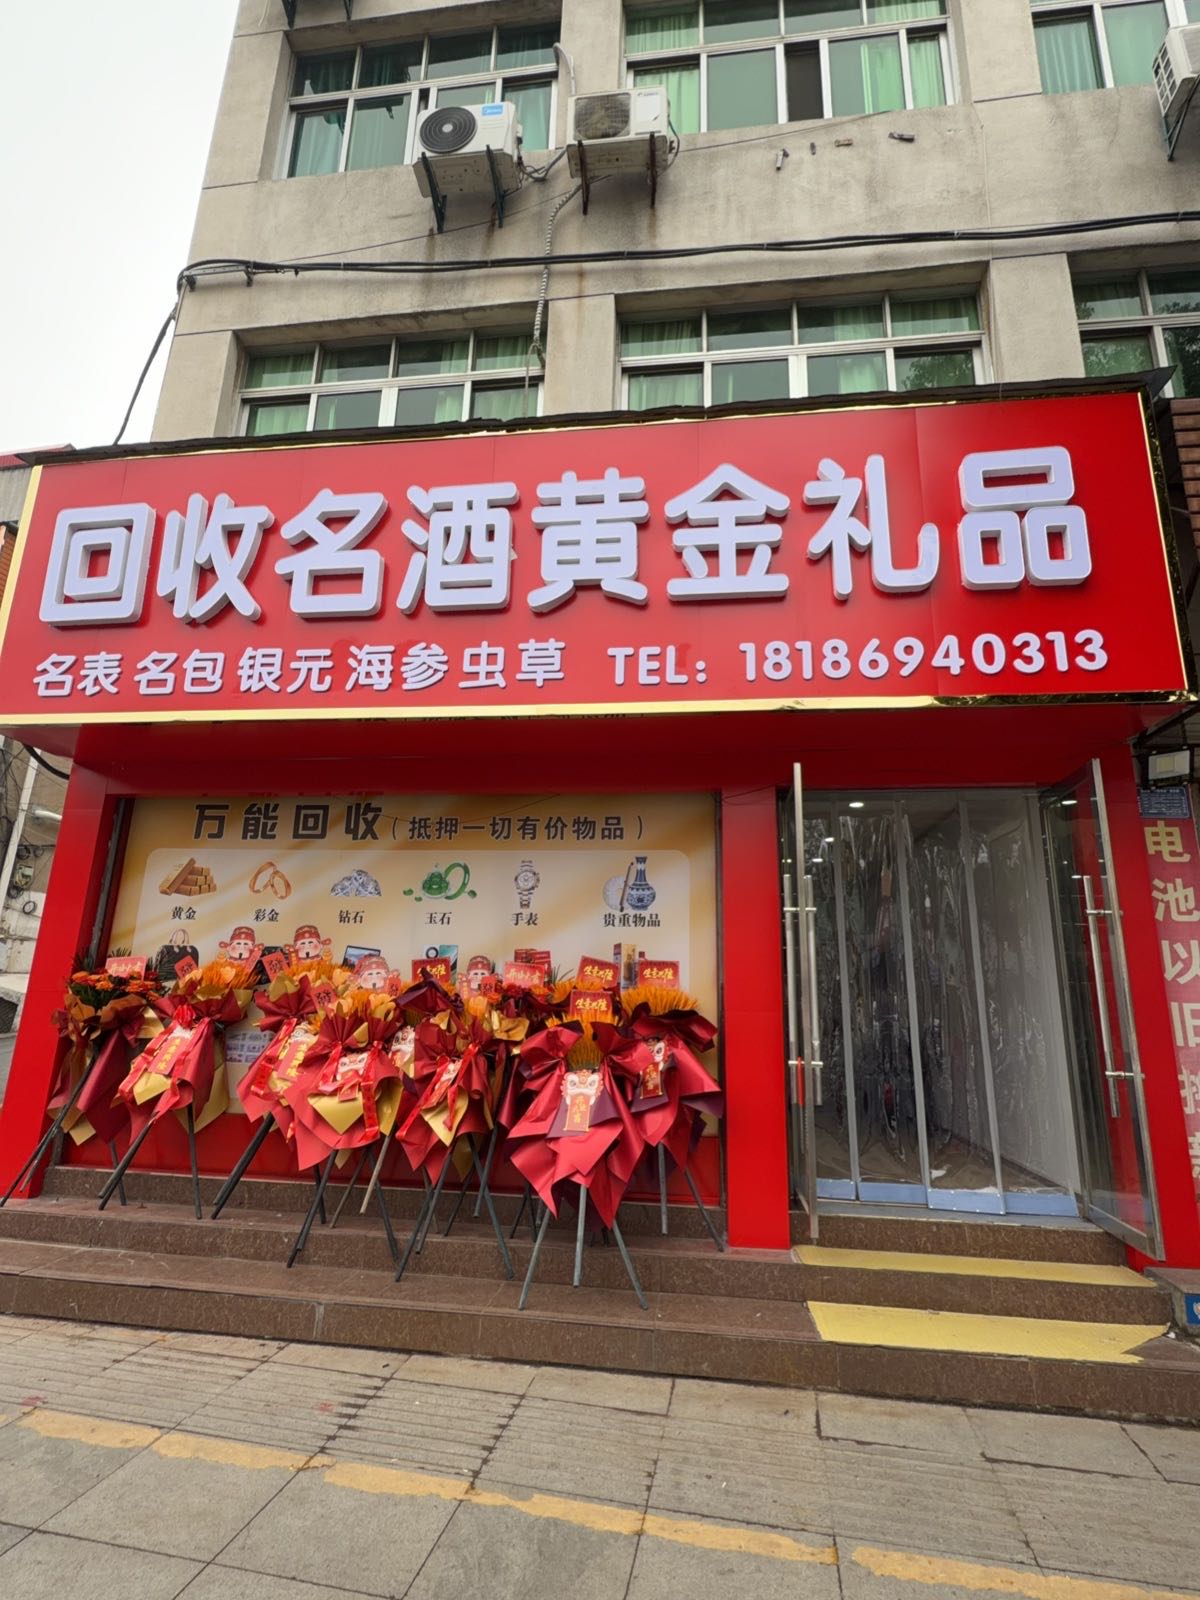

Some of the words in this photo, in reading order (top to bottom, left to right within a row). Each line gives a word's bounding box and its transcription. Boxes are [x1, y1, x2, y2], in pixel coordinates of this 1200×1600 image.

[39, 446, 1093, 626] 回收名酒黄金礼品
[738, 629, 1108, 681] 18186940313
[171, 906, 197, 920] 黄金
[253, 908, 280, 922] 彩金
[338, 910, 365, 924] 钻石
[424, 912, 452, 926] 玉石
[511, 912, 538, 927] 手表
[602, 913, 661, 928] 贵重物品
